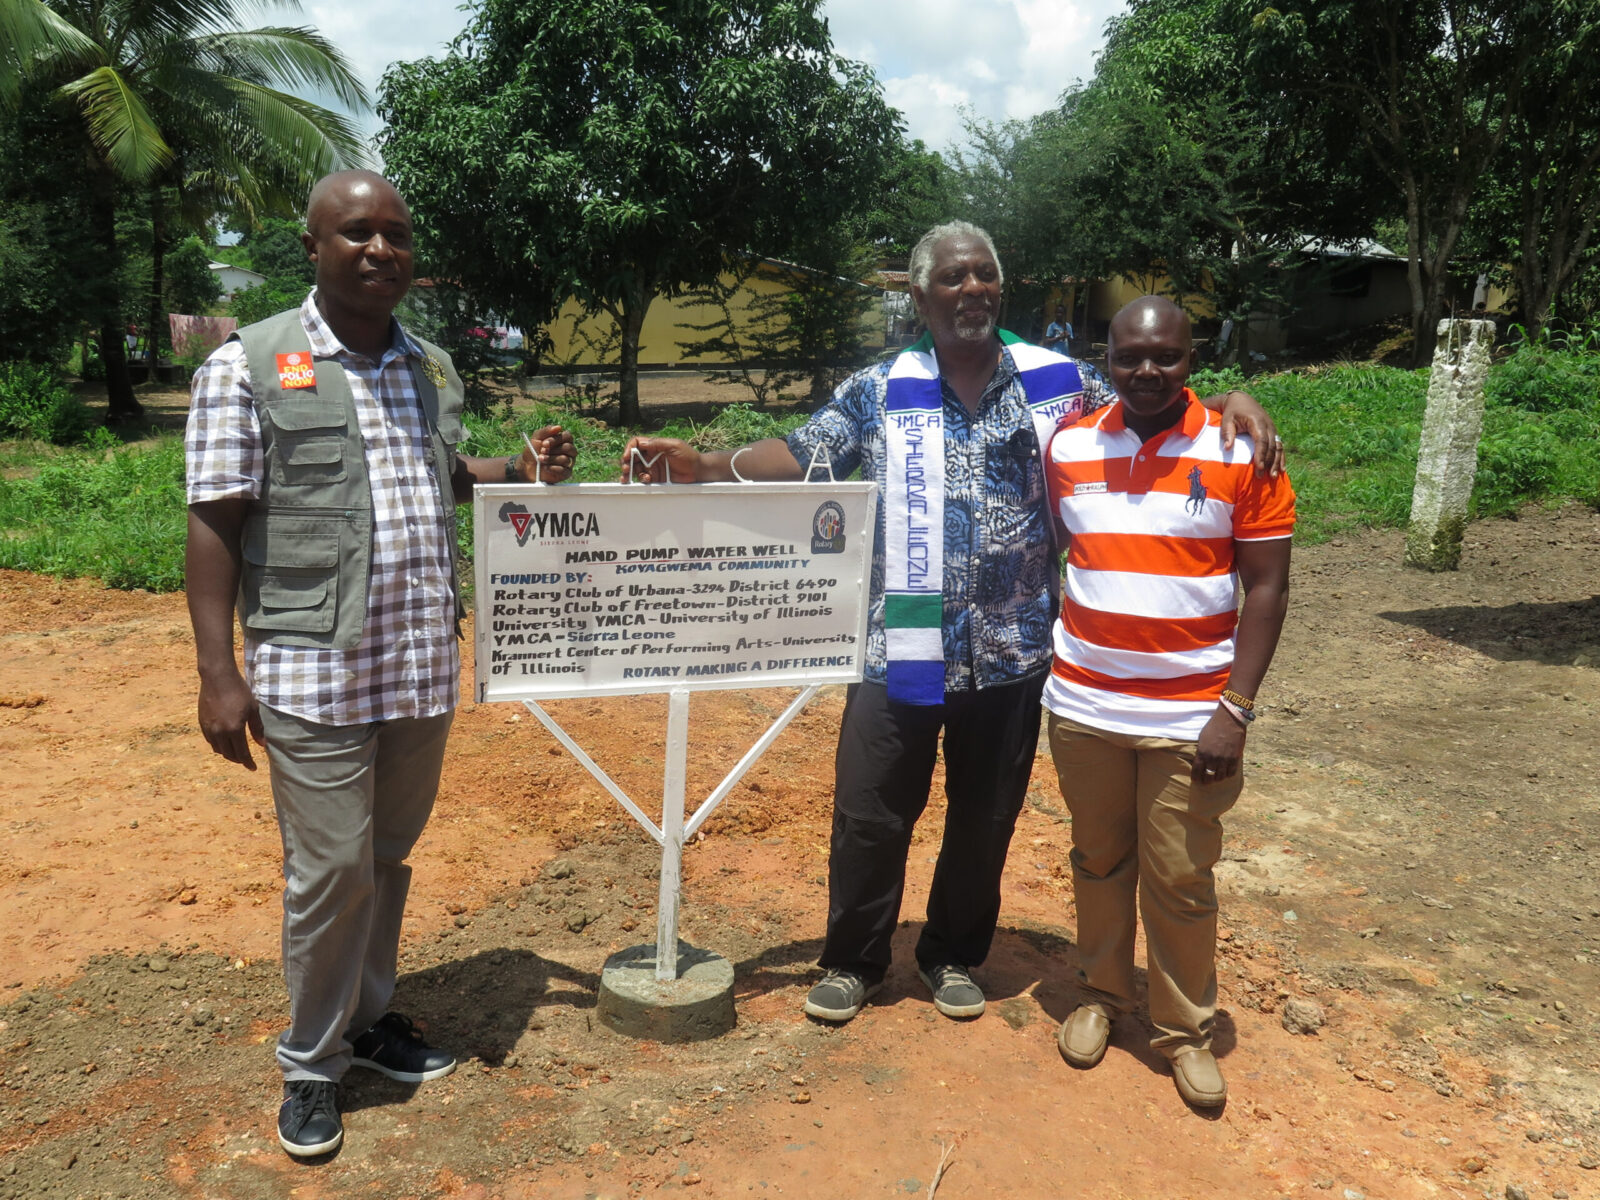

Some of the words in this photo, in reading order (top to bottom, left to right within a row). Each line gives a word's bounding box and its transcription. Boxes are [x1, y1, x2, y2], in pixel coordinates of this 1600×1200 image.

[279, 369, 314, 381] POLIO
[283, 364, 309, 374] END
[284, 377, 313, 387] NOW
[1035, 397, 1082, 419] YMCA
[890, 414, 941, 429] YMCA
[905, 428, 928, 514] SIERRA
[534, 512, 600, 538] YMCA
[565, 550, 618, 564] HAND
[626, 548, 680, 560] PUMP
[688, 545, 747, 558] WATER
[752, 544, 797, 556] WELL
[814, 540, 833, 549] Rotary
[907, 515, 929, 589] LEONE
[615, 562, 713, 574] KOYAGWEMA
[718, 559, 810, 571] COMMUNITY
[491, 573, 561, 585] FOUNDED
[565, 572, 593, 583] BY:
[494, 589, 561, 602] Rotary
[565, 587, 602, 598] Club
[605, 586, 624, 598] of
[628, 584, 727, 597] Urbana-3294
[729, 579, 790, 592] District
[796, 578, 837, 590] 6490
[493, 604, 561, 618] Rotary
[564, 601, 602, 613] Club
[607, 600, 630, 612] of
[797, 592, 828, 603] 9101
[493, 617, 587, 632] University
[753, 607, 772, 620] of
[777, 605, 832, 619] Illinois
[622, 629, 676, 640] Leone
[492, 648, 562, 662] Krannert
[566, 646, 618, 658] Center
[621, 644, 639, 655] of
[642, 642, 731, 654] Performing
[492, 661, 512, 675] of
[521, 663, 587, 674] Illinois
[623, 666, 681, 679] ROTARY
[685, 661, 747, 676] MAKING
[751, 661, 763, 671] A
[767, 655, 854, 670] DIFFERENCE
